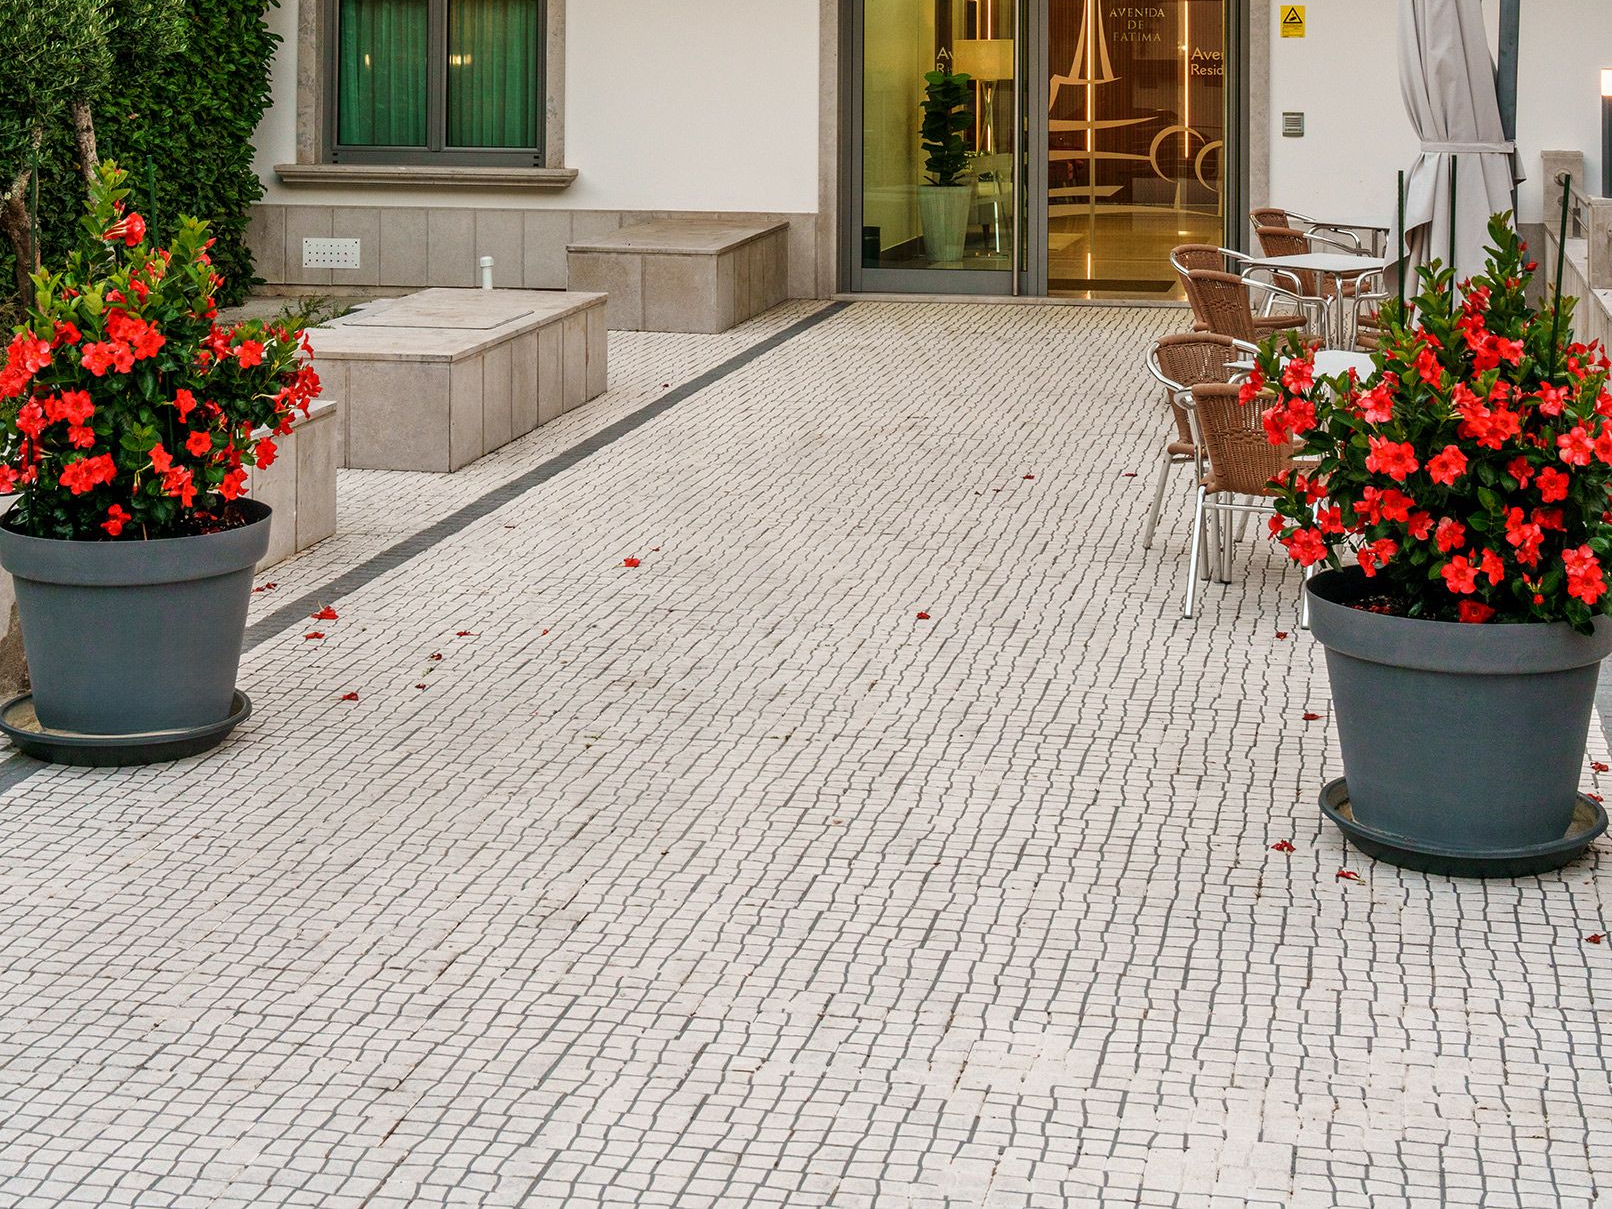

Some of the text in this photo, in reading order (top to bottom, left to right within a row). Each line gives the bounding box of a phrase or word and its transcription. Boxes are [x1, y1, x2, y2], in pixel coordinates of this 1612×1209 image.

[1109, 7, 1165, 17] AVENIDA
[1127, 20, 1144, 30] DE
[1113, 32, 1161, 42] FATIMA
